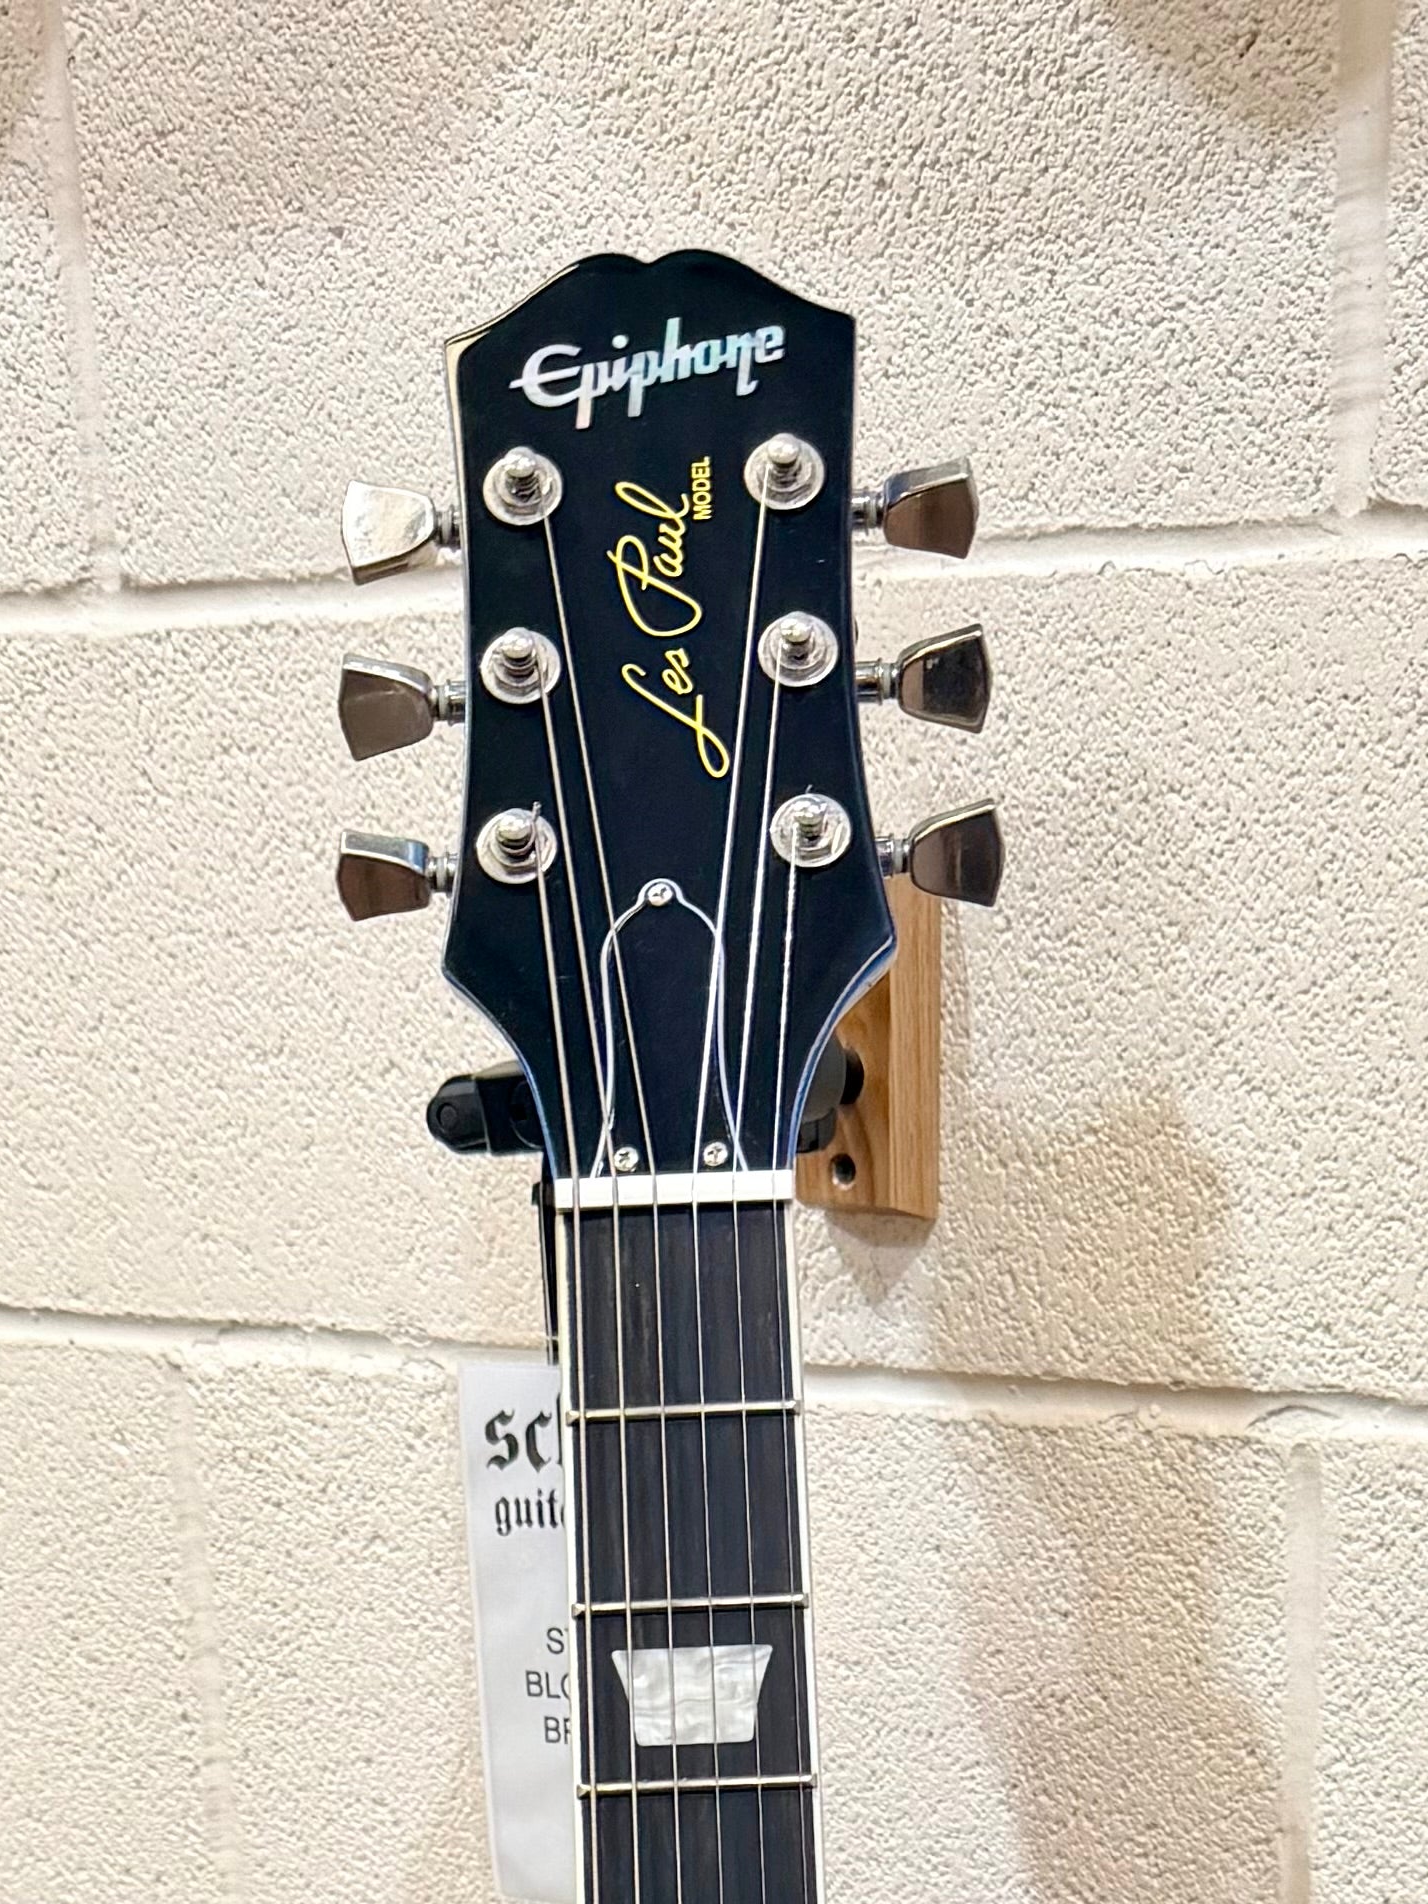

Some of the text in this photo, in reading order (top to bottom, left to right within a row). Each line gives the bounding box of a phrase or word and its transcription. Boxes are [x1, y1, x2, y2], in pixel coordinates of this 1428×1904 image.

[509, 316, 786, 430] Epiphone
[693, 456, 711, 520] MODEL
[608, 480, 729, 778] Les Paul
